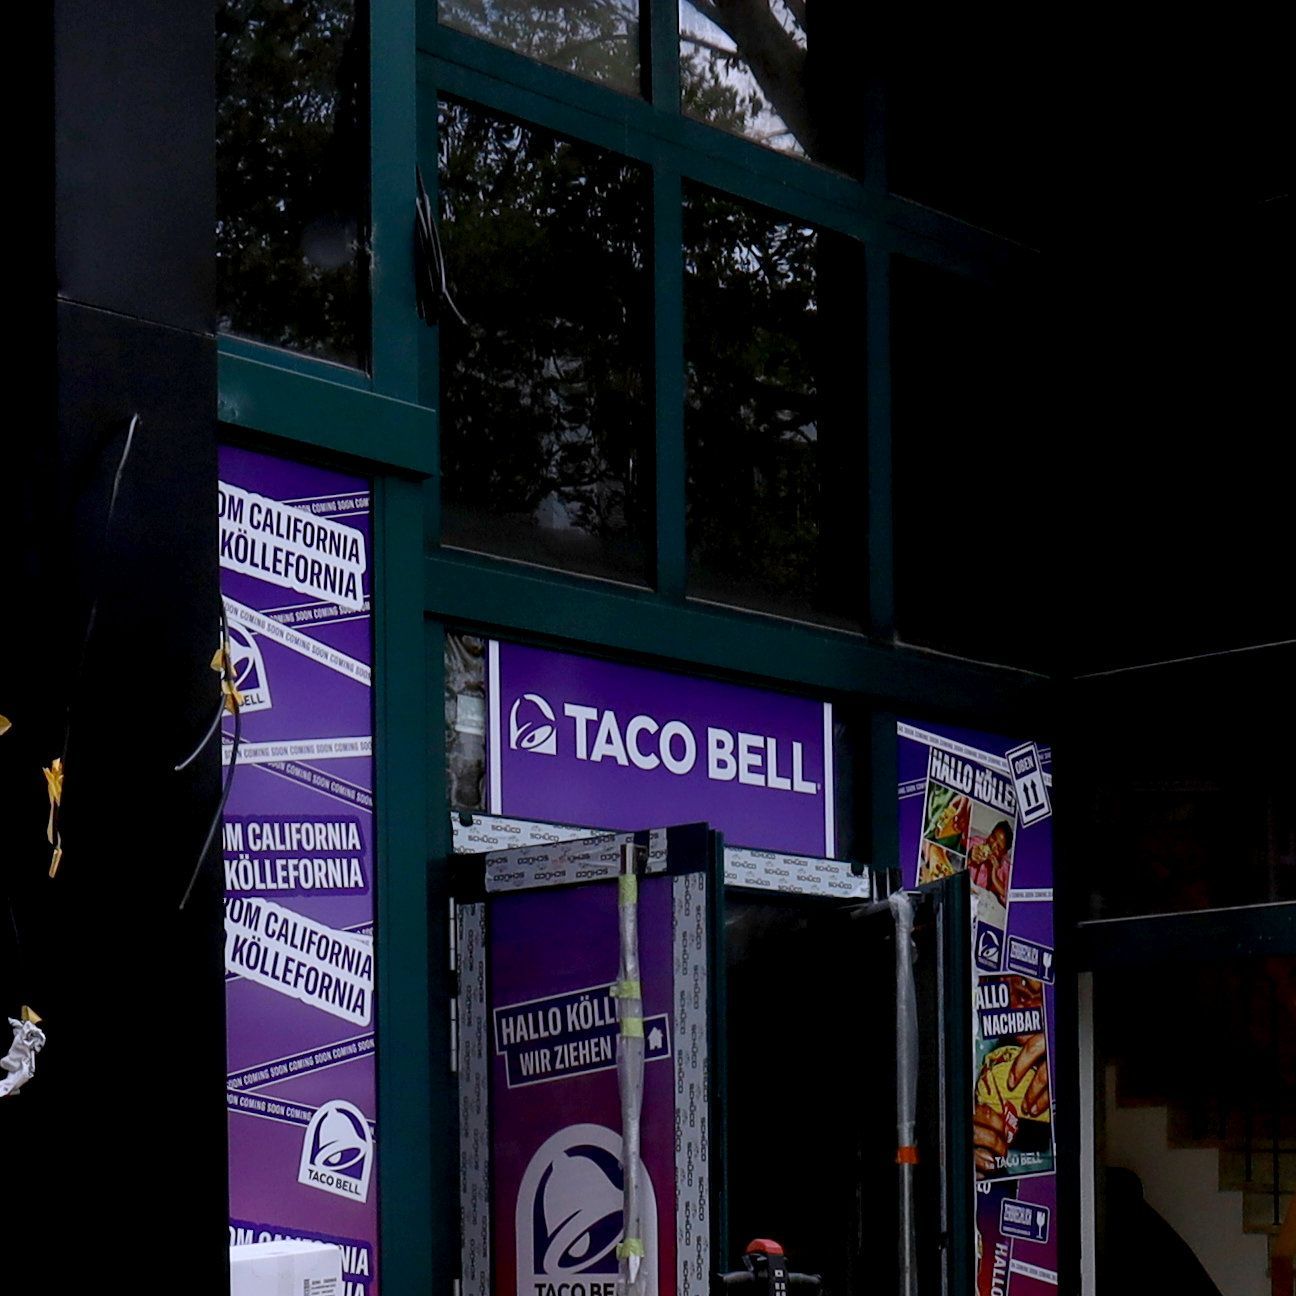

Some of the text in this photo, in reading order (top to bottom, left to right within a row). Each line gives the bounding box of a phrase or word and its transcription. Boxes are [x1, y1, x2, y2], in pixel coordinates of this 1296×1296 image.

[218, 490, 360, 564] OM CALIFORNIA
[221, 528, 357, 600] KÖLLEFORNIA
[240, 609, 354, 673] COMING SOON COMING SOON COMING
[239, 693, 263, 706] ELL
[271, 742, 358, 756] SOON COMING SOON COMING
[564, 702, 697, 775] TACO
[707, 726, 817, 795] BELL
[931, 747, 973, 793] HALLO
[247, 822, 361, 851] CALIFORNIA
[225, 854, 364, 890] KÖLLEFORNIA
[265, 911, 372, 981] CALIFORNIA
[231, 934, 364, 1017] KÖLLEFORNIA
[976, 983, 1009, 1010] ALLO
[501, 995, 620, 1045] HALLO KÖLL
[983, 1010, 1041, 1036] NACHBAR
[270, 1044, 357, 1078] SOON COMING SOON COMING
[520, 1035, 612, 1076] WIR ZIEHEN
[240, 1097, 285, 1115] COMING SOON
[308, 1169, 360, 1195] TACO BELL
